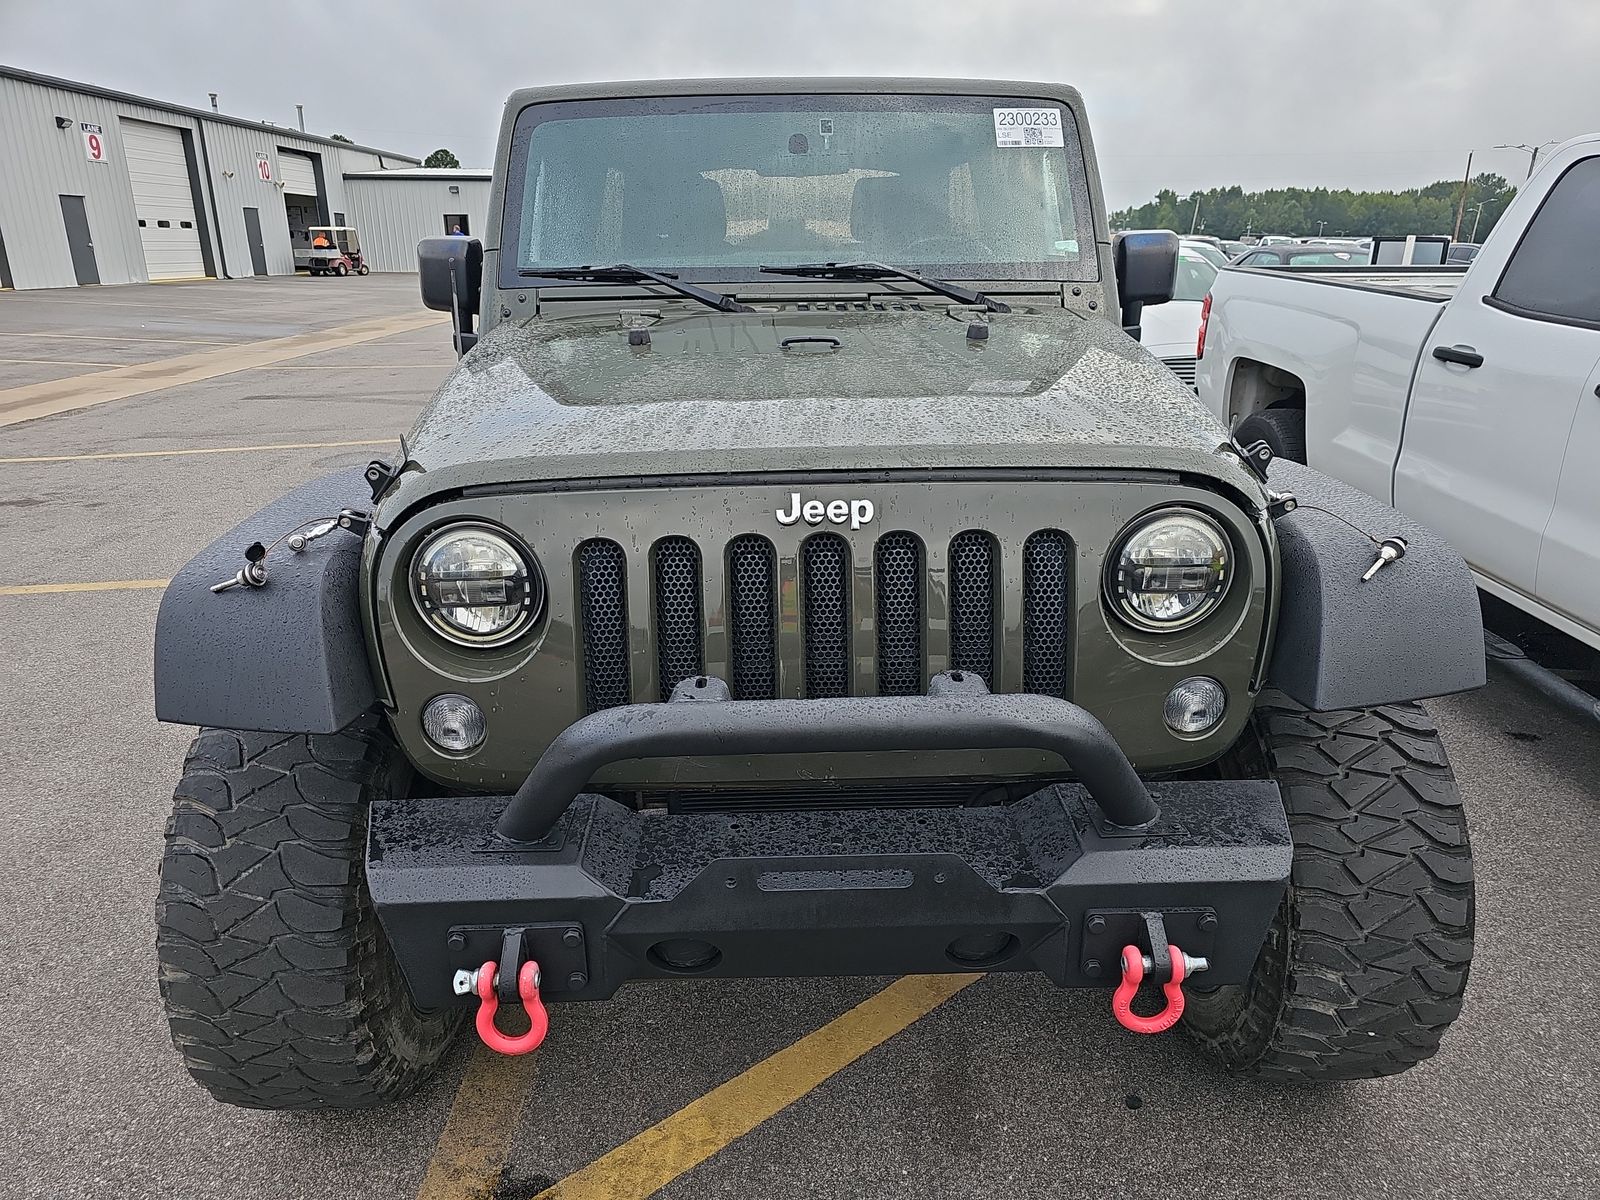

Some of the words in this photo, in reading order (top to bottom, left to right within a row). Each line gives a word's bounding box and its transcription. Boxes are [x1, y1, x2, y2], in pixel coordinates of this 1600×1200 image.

[83, 123, 100, 133] LANE
[998, 112, 1058, 126] 2300233
[88, 134, 102, 160] 9
[258, 160, 270, 180] 10
[775, 492, 875, 531] Jeep
